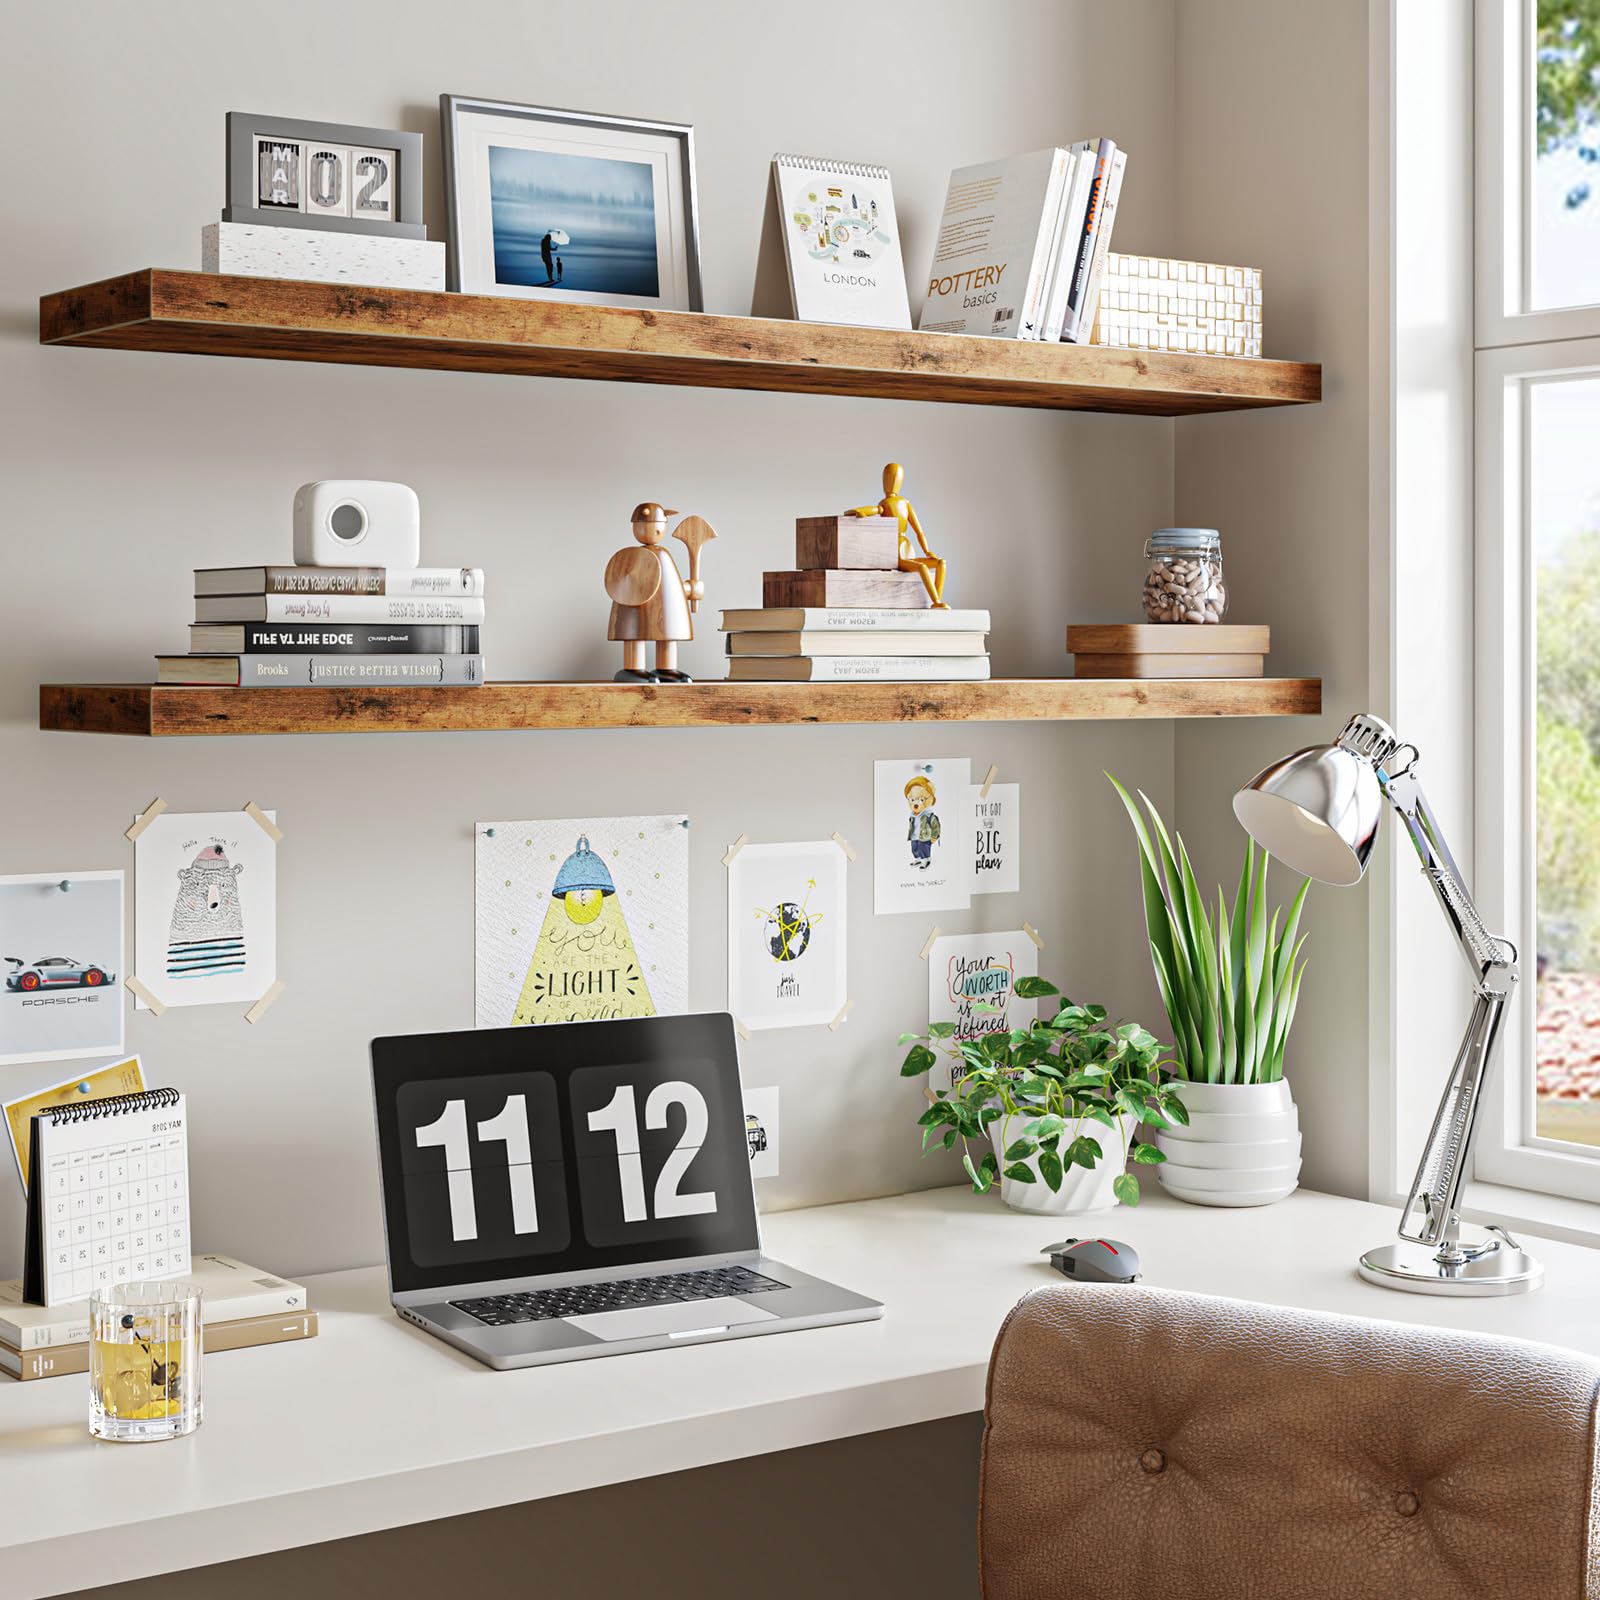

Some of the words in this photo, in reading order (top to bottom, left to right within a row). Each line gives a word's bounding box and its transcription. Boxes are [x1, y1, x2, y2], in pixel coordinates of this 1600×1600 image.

[272, 146, 292, 204] MAR
[310, 151, 389, 212] 02
[823, 273, 876, 288] LONDON
[928, 264, 1006, 298] POTTERY
[962, 290, 997, 308] basics
[258, 664, 288, 675] Brooks
[976, 804, 987, 816] I'VE
[990, 803, 1001, 816] GOT
[976, 831, 1001, 854] BIG
[976, 854, 1002, 874] plans
[554, 958, 576, 967] ARE
[587, 954, 608, 964] THE
[549, 969, 620, 996] LIGHT
[953, 956, 995, 995] Your
[965, 972, 1008, 996] WORTH
[22, 995, 99, 1006] PORSCHE
[560, 1001, 571, 1009] OF
[957, 1001, 972, 1016] is
[954, 1013, 1008, 1042] defined
[416, 1094, 538, 1242] 11
[587, 1080, 718, 1222] 12
